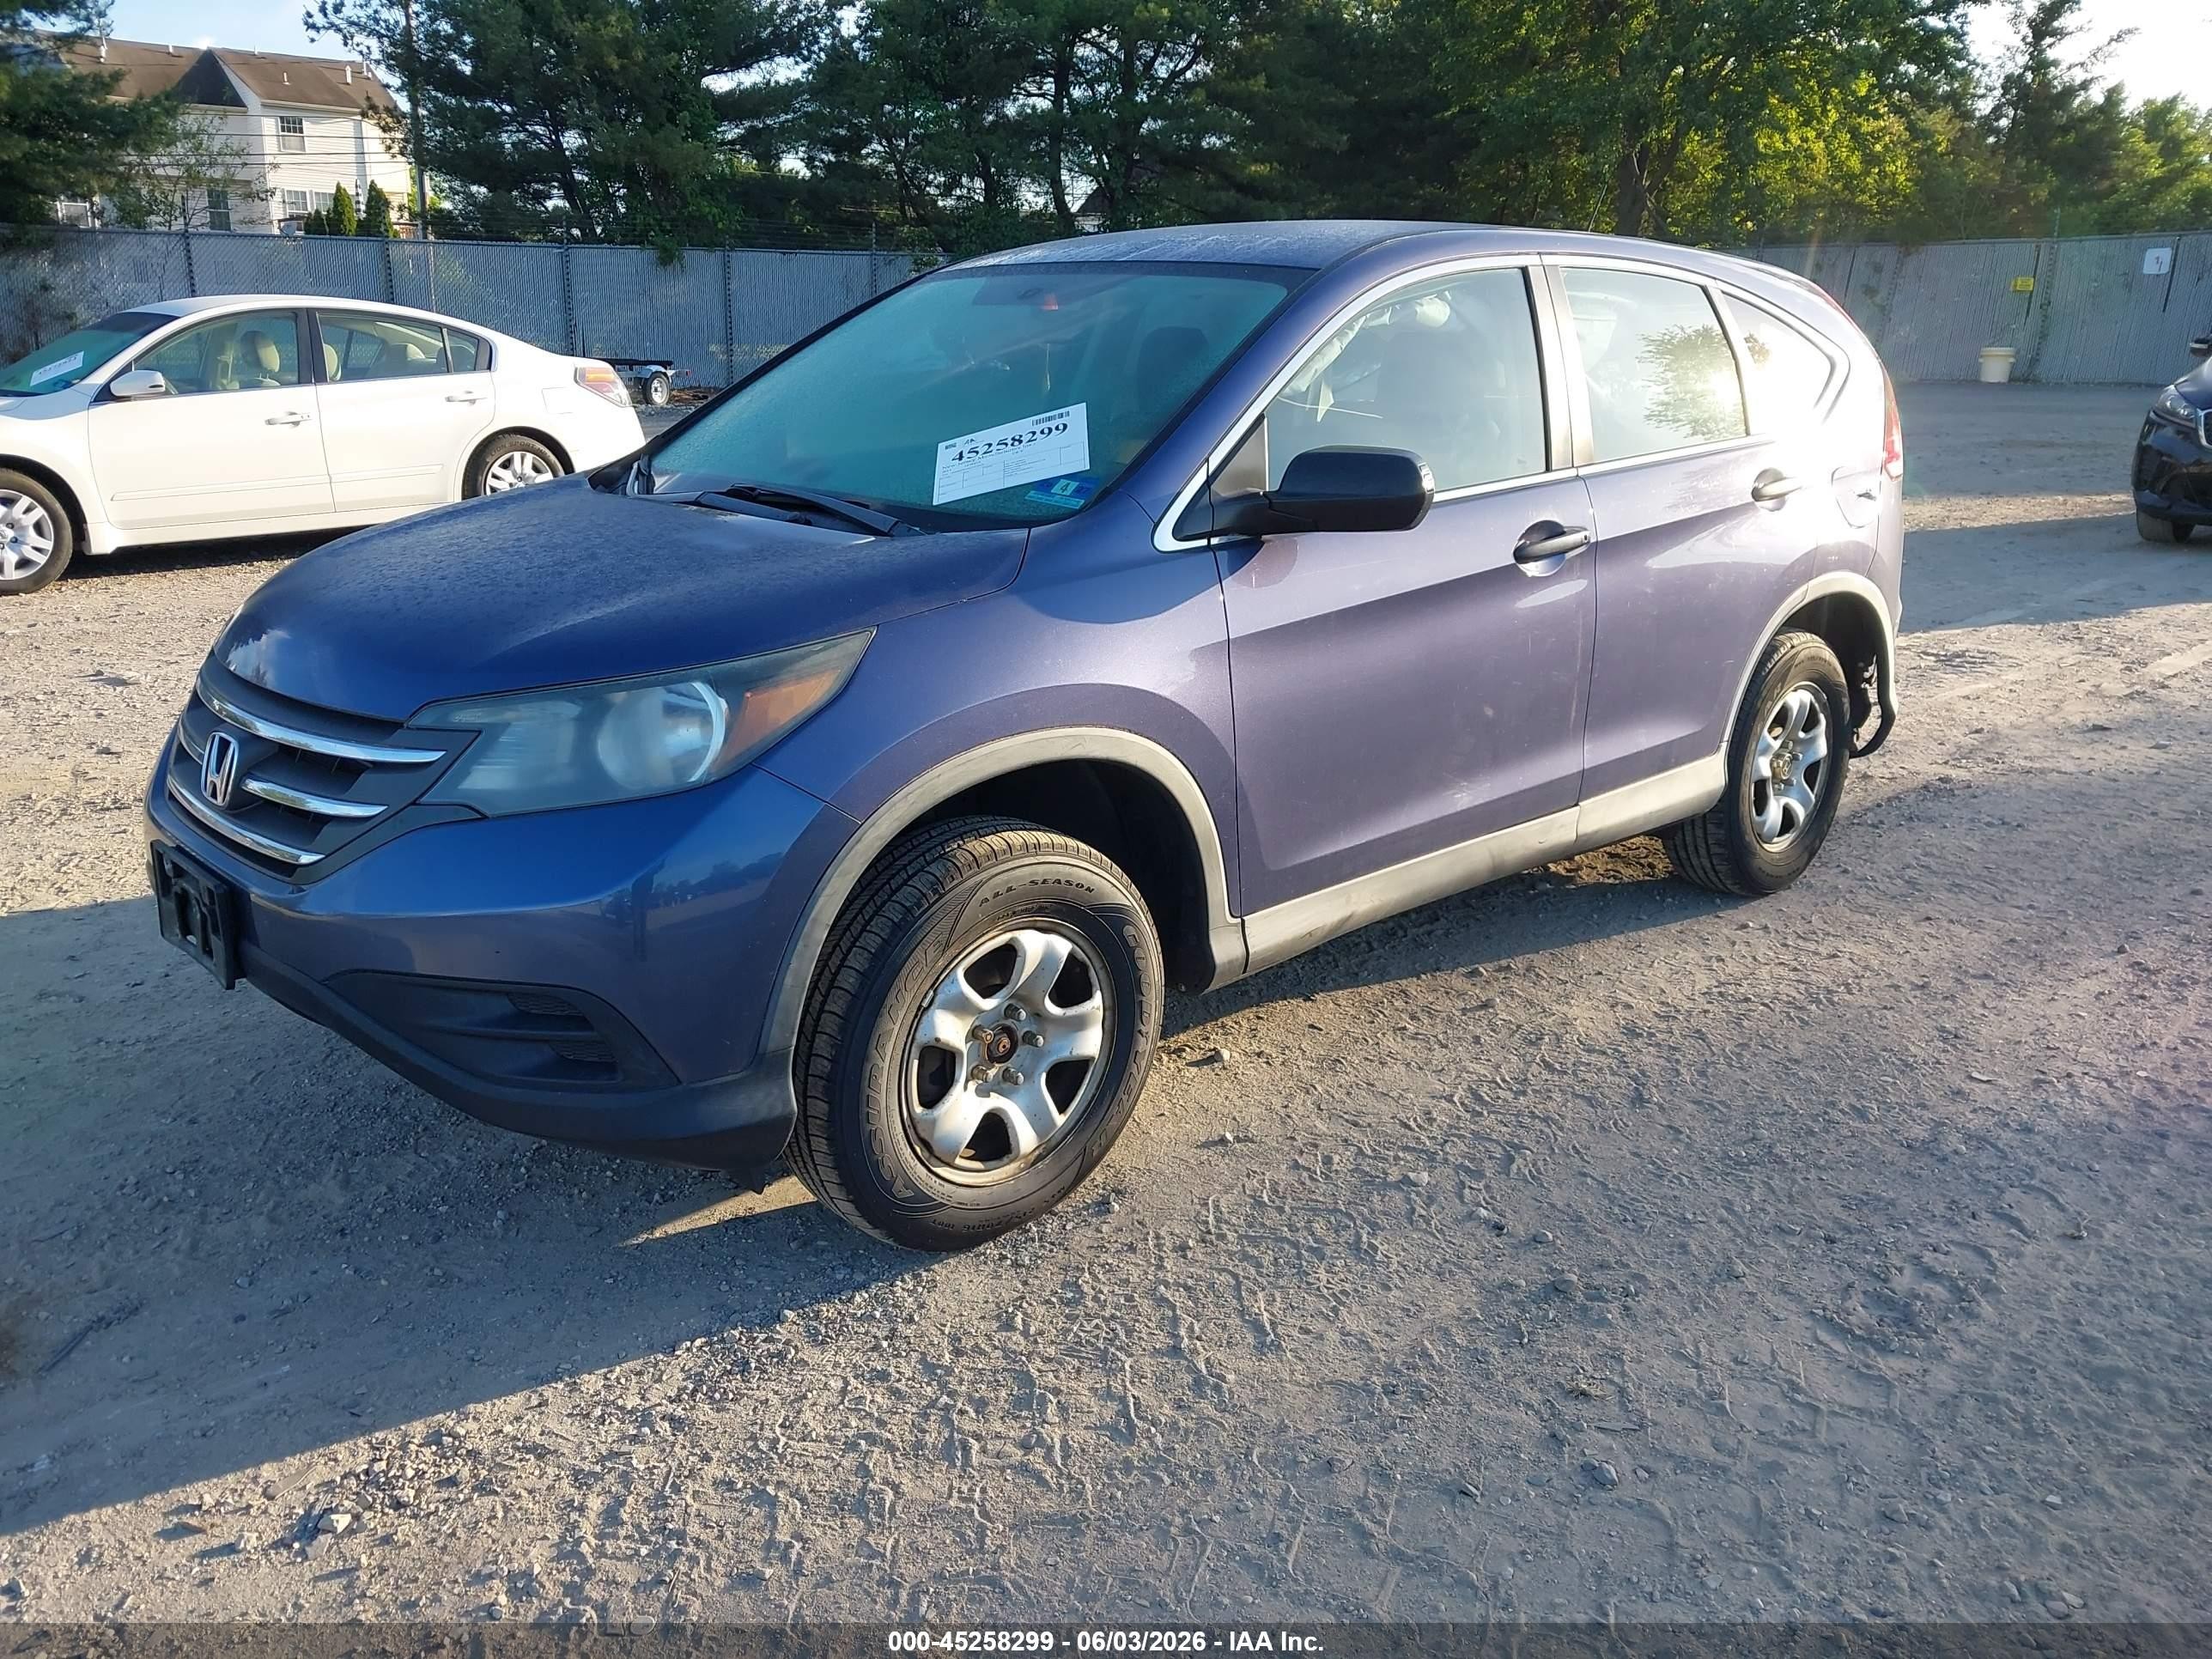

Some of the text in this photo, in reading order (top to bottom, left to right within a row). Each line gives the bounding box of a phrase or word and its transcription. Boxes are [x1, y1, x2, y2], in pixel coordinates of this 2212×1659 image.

[951, 422, 1068, 462] 45258299
[1060, 481, 1071, 494] 4
[979, 878, 1095, 908] ALL-SEASON
[1092, 924, 1152, 1158] GOODYEAR
[866, 931, 945, 1200] ASSURANCE
